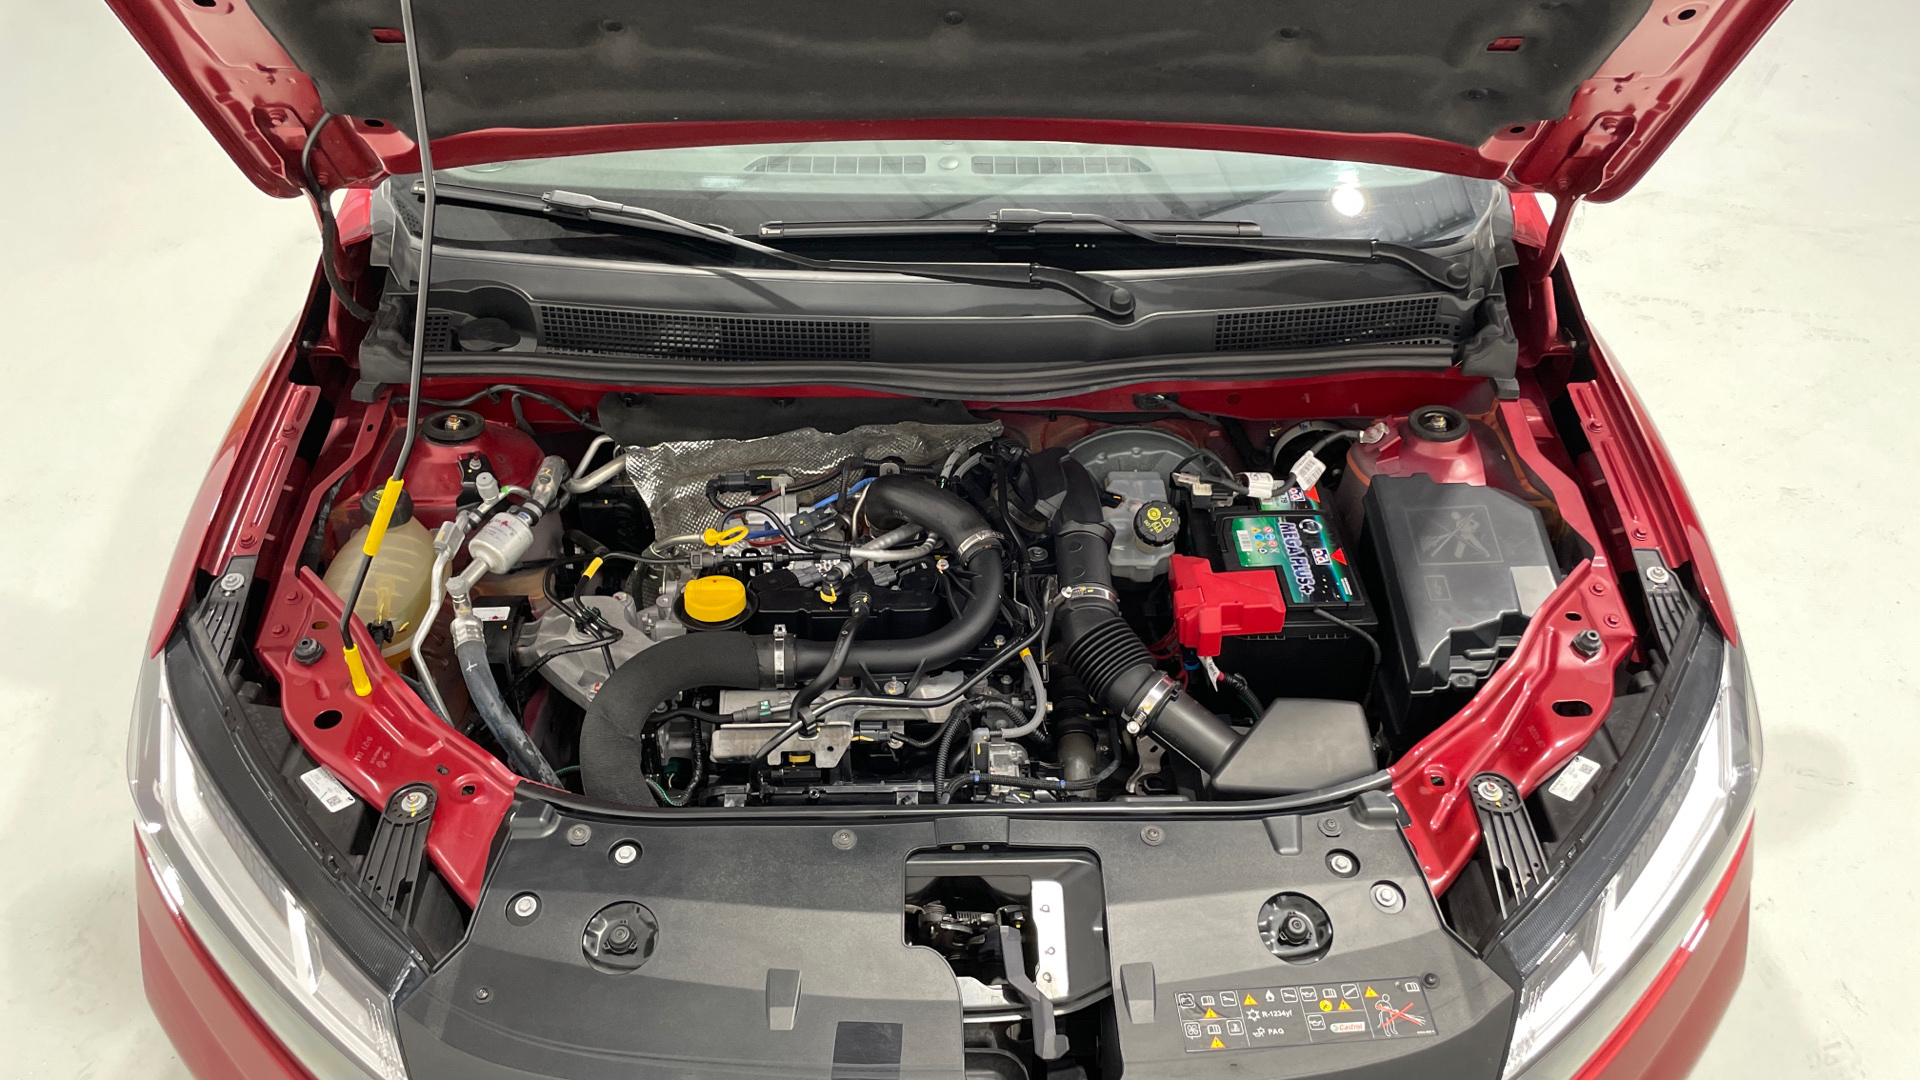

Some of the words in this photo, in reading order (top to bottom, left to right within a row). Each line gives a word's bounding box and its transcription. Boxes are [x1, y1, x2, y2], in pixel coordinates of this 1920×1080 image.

[1278, 522, 1302, 557] MEGA
[1289, 557, 1316, 595] PLUS+
[1339, 1023, 1363, 1031] Castrol
